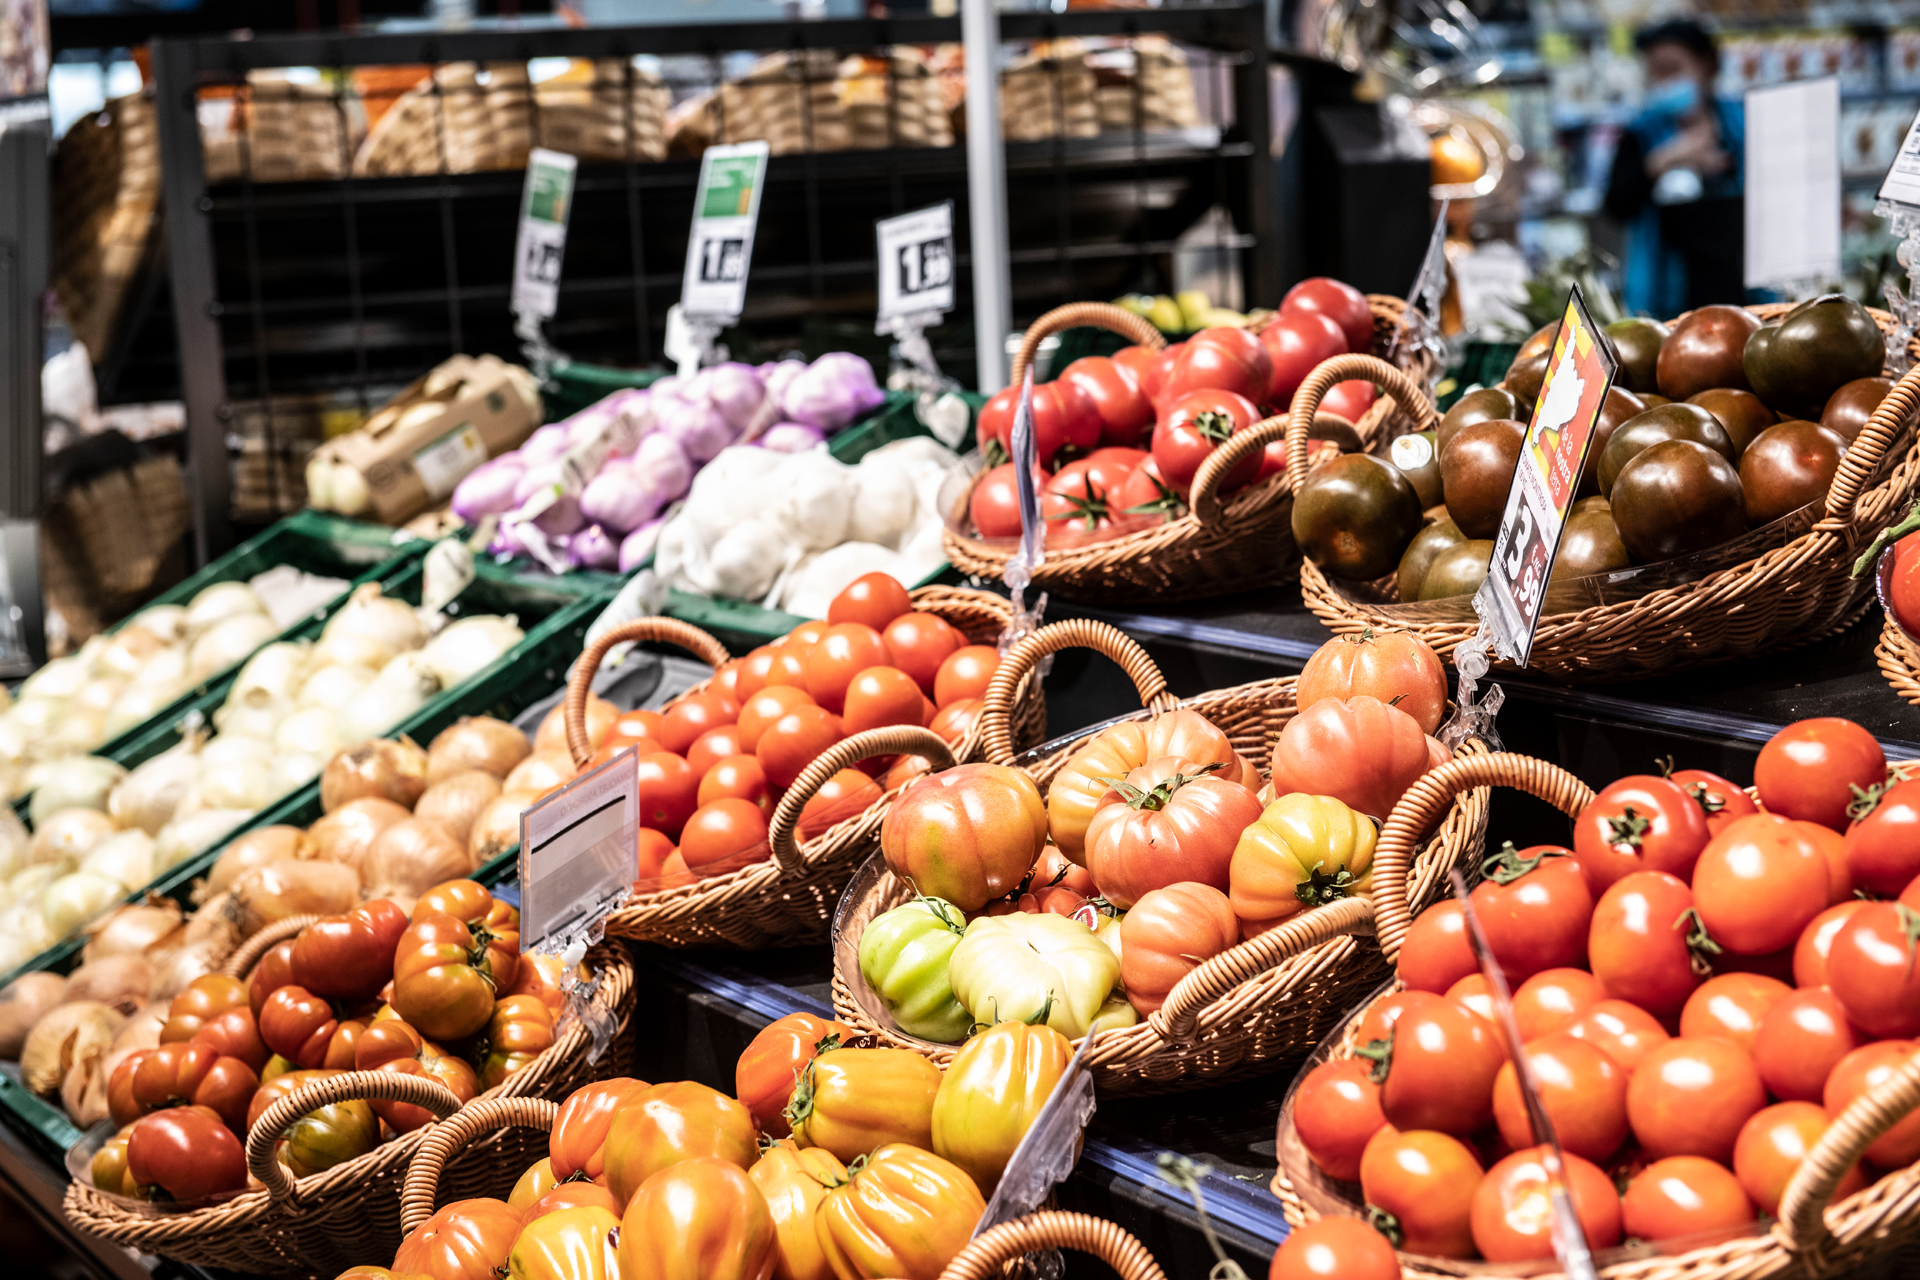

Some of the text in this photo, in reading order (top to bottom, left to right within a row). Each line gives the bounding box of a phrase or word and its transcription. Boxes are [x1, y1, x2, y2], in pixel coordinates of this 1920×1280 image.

[1561, 425, 1573, 456] de la
[1555, 446, 1571, 485] nostra
[1550, 466, 1561, 497] terra
